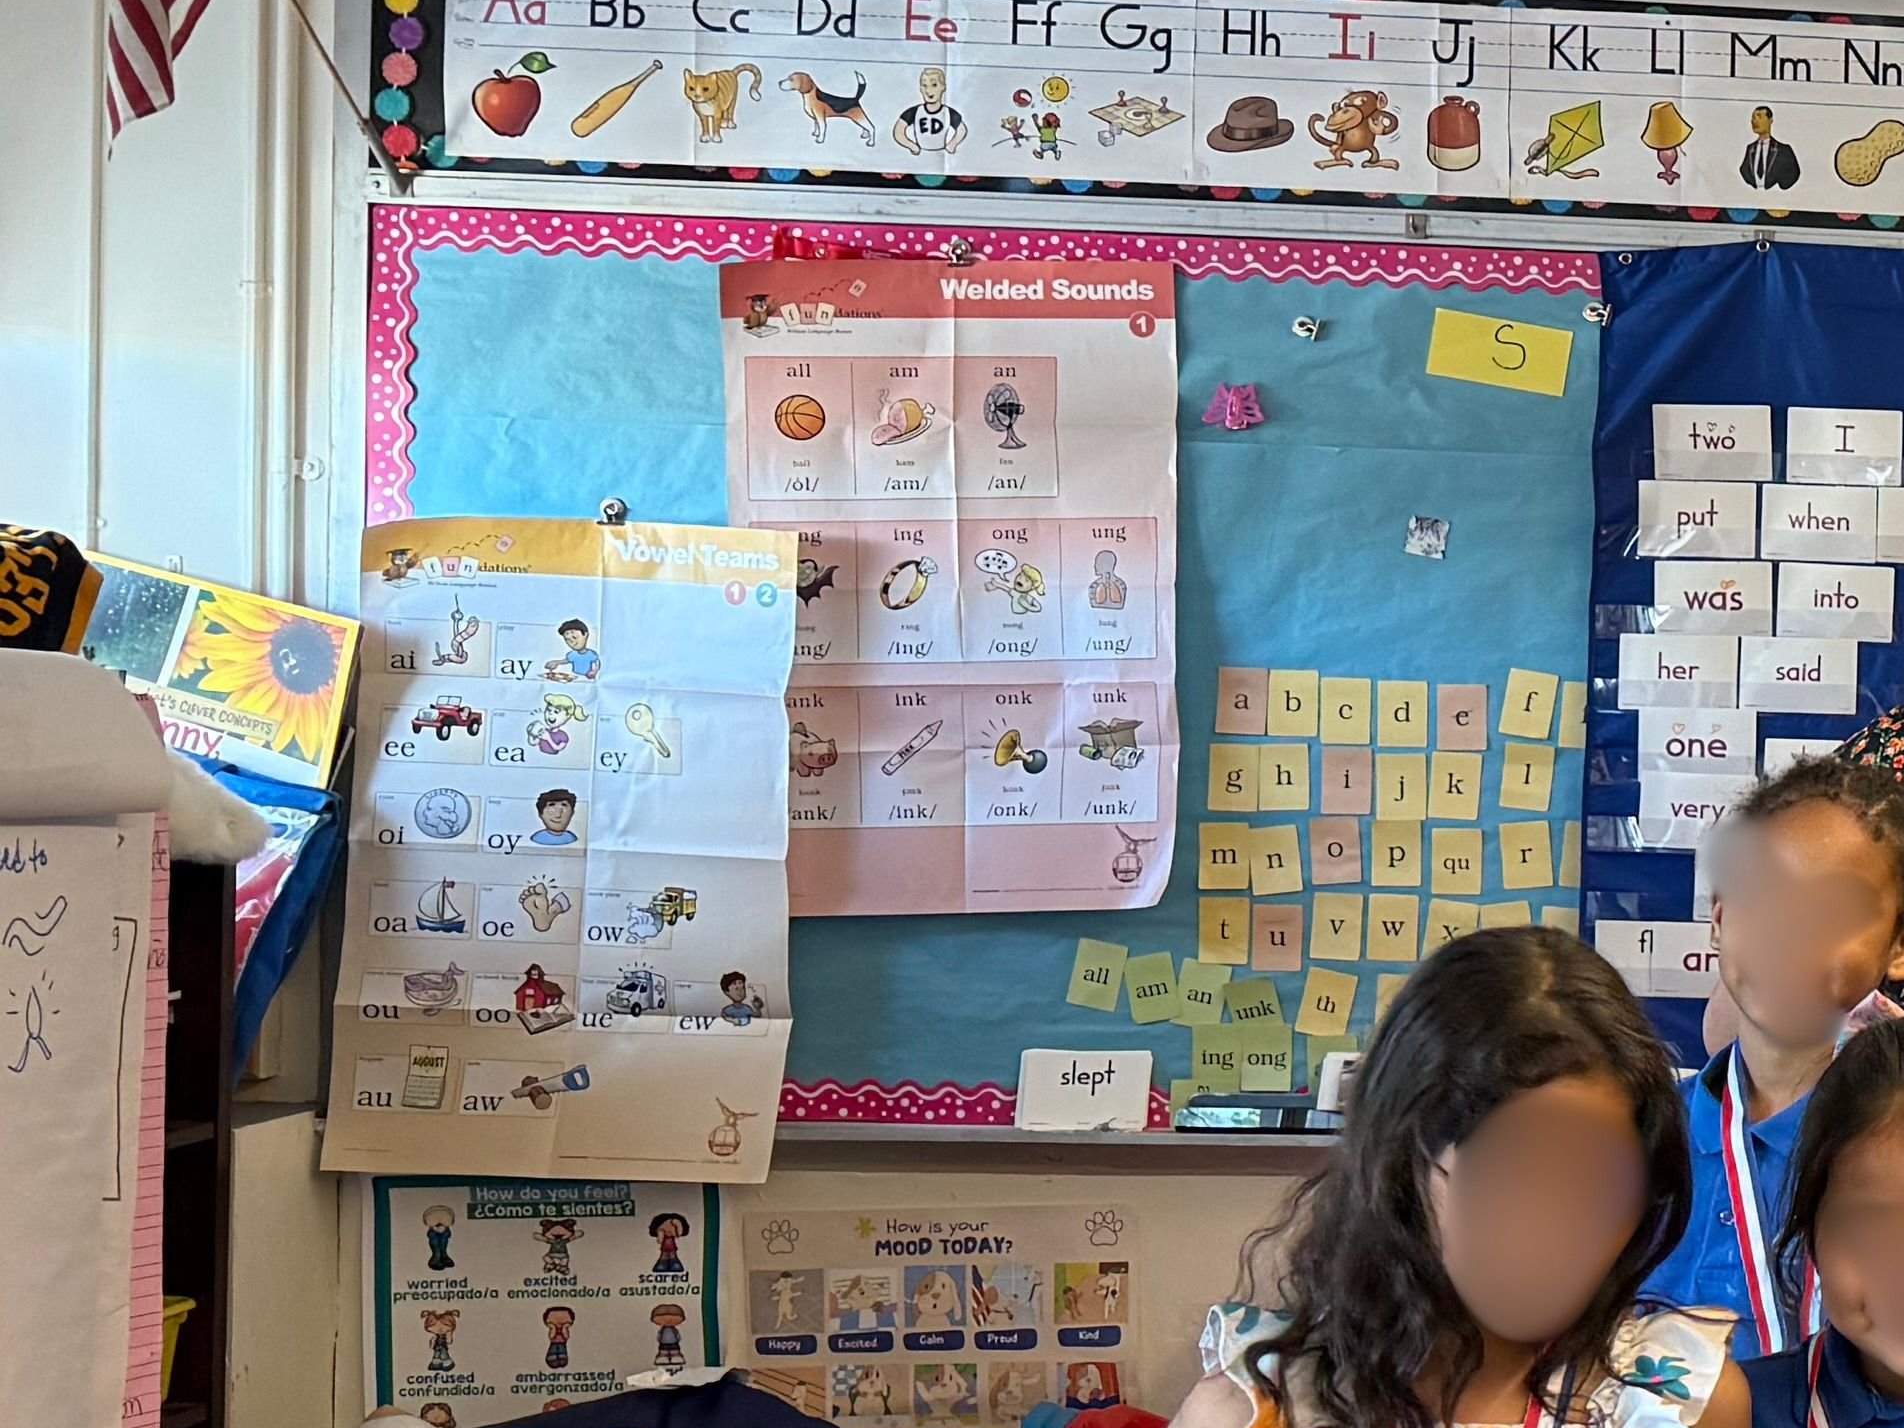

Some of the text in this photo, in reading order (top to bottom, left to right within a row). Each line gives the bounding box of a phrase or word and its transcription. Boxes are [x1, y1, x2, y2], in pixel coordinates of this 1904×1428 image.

[1012, 0, 1057, 41] Ff
[1100, 4, 1174, 73] Gg
[1222, 10, 1281, 57] Hh
[1328, 14, 1374, 61] Ii
[1430, 18, 1475, 86] Jj
[1548, 24, 1602, 72] Kk
[1731, 34, 1811, 81] Mm
[1845, 39, 1902, 86] Nn
[919, 117, 942, 136] ED
[941, 279, 1154, 301] Welded Sounds
[1491, 323, 1527, 371] S
[787, 363, 1016, 378] all am an
[1689, 422, 1855, 452] two I
[1677, 500, 1718, 540] put
[1789, 508, 1850, 532] when
[893, 525, 1126, 544] ing ong ung
[616, 539, 778, 571] Vowel Teams
[1684, 586, 1859, 613] was into
[392, 650, 532, 680] ai ay
[1658, 652, 1821, 683] her said
[180, 701, 217, 720] CLEVER
[384, 740, 626, 770] ee ea ey
[1666, 733, 1727, 760] one
[1671, 800, 1724, 824] very
[378, 828, 522, 854] oi oy
[1443, 854, 1471, 876] qu
[374, 916, 623, 942] oa ow
[1083, 966, 1335, 1020] all am an unk th
[1202, 1049, 1286, 1070] ing ong
[1060, 1059, 1115, 1096] slept
[358, 1088, 503, 1111] au aw
[476, 1184, 628, 1202] How do you feel?
[539, 1204, 555, 1215] te
[887, 1219, 989, 1239] How is your
[876, 1237, 1012, 1256] MOOD TODAY?
[408, 1272, 689, 1289] worried excited scared
[769, 1330, 1100, 1351] Happy Excited Calm Proud Kind
[407, 1373, 474, 1384] confused
